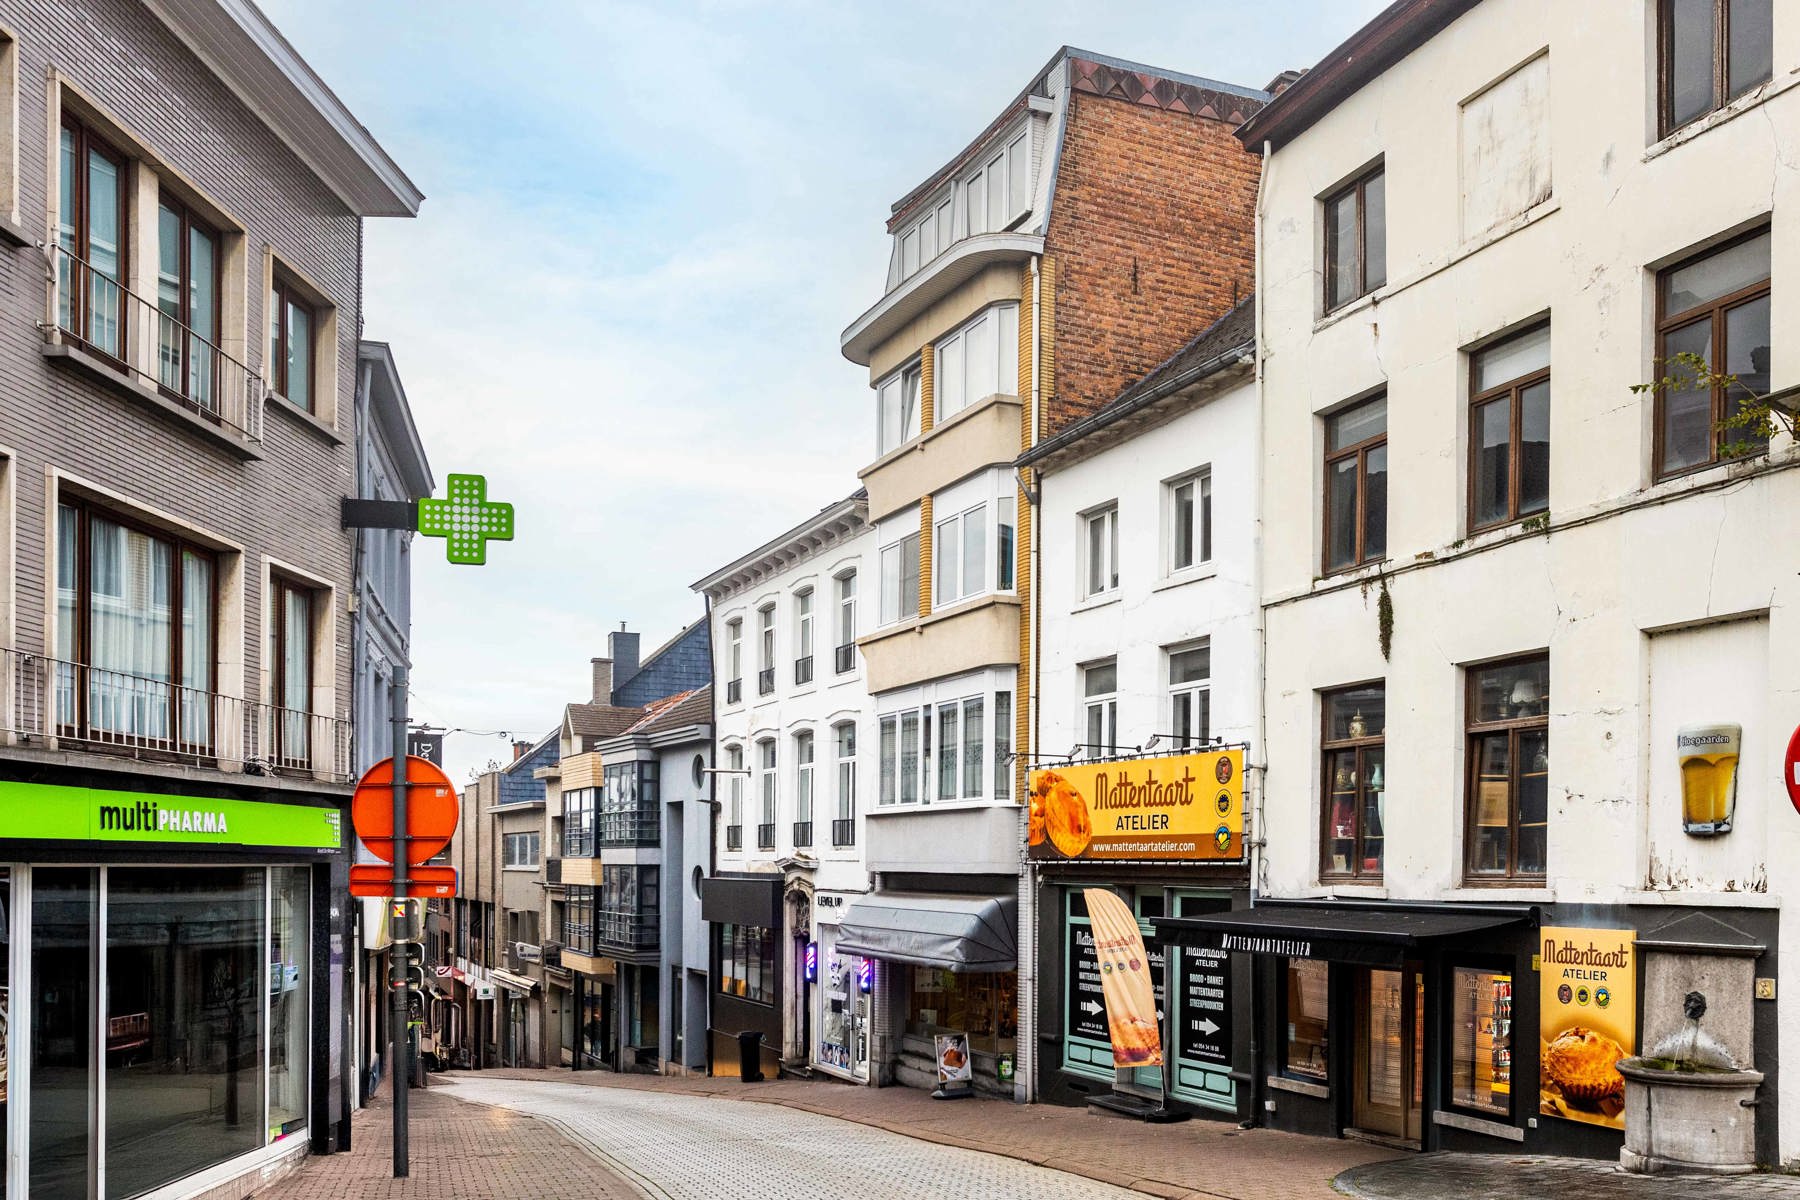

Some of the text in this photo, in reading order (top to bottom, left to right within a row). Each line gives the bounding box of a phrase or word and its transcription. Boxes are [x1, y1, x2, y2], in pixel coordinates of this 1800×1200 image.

[1681, 734, 1730, 747] Hoegaarden
[1094, 766, 1196, 810] Mattentaart
[99, 800, 228, 833] multiPHARMA
[1116, 814, 1169, 831] ATELIER
[1092, 841, 1196, 852] www.mattentaartatelier.com
[817, 896, 843, 907] LEVEL UP
[1222, 933, 1311, 956] MATTENTAARTATELIER
[1543, 939, 1628, 969] Mattentaart
[1195, 959, 1219, 968] ATELIER
[1562, 968, 1608, 981] ATELIER
